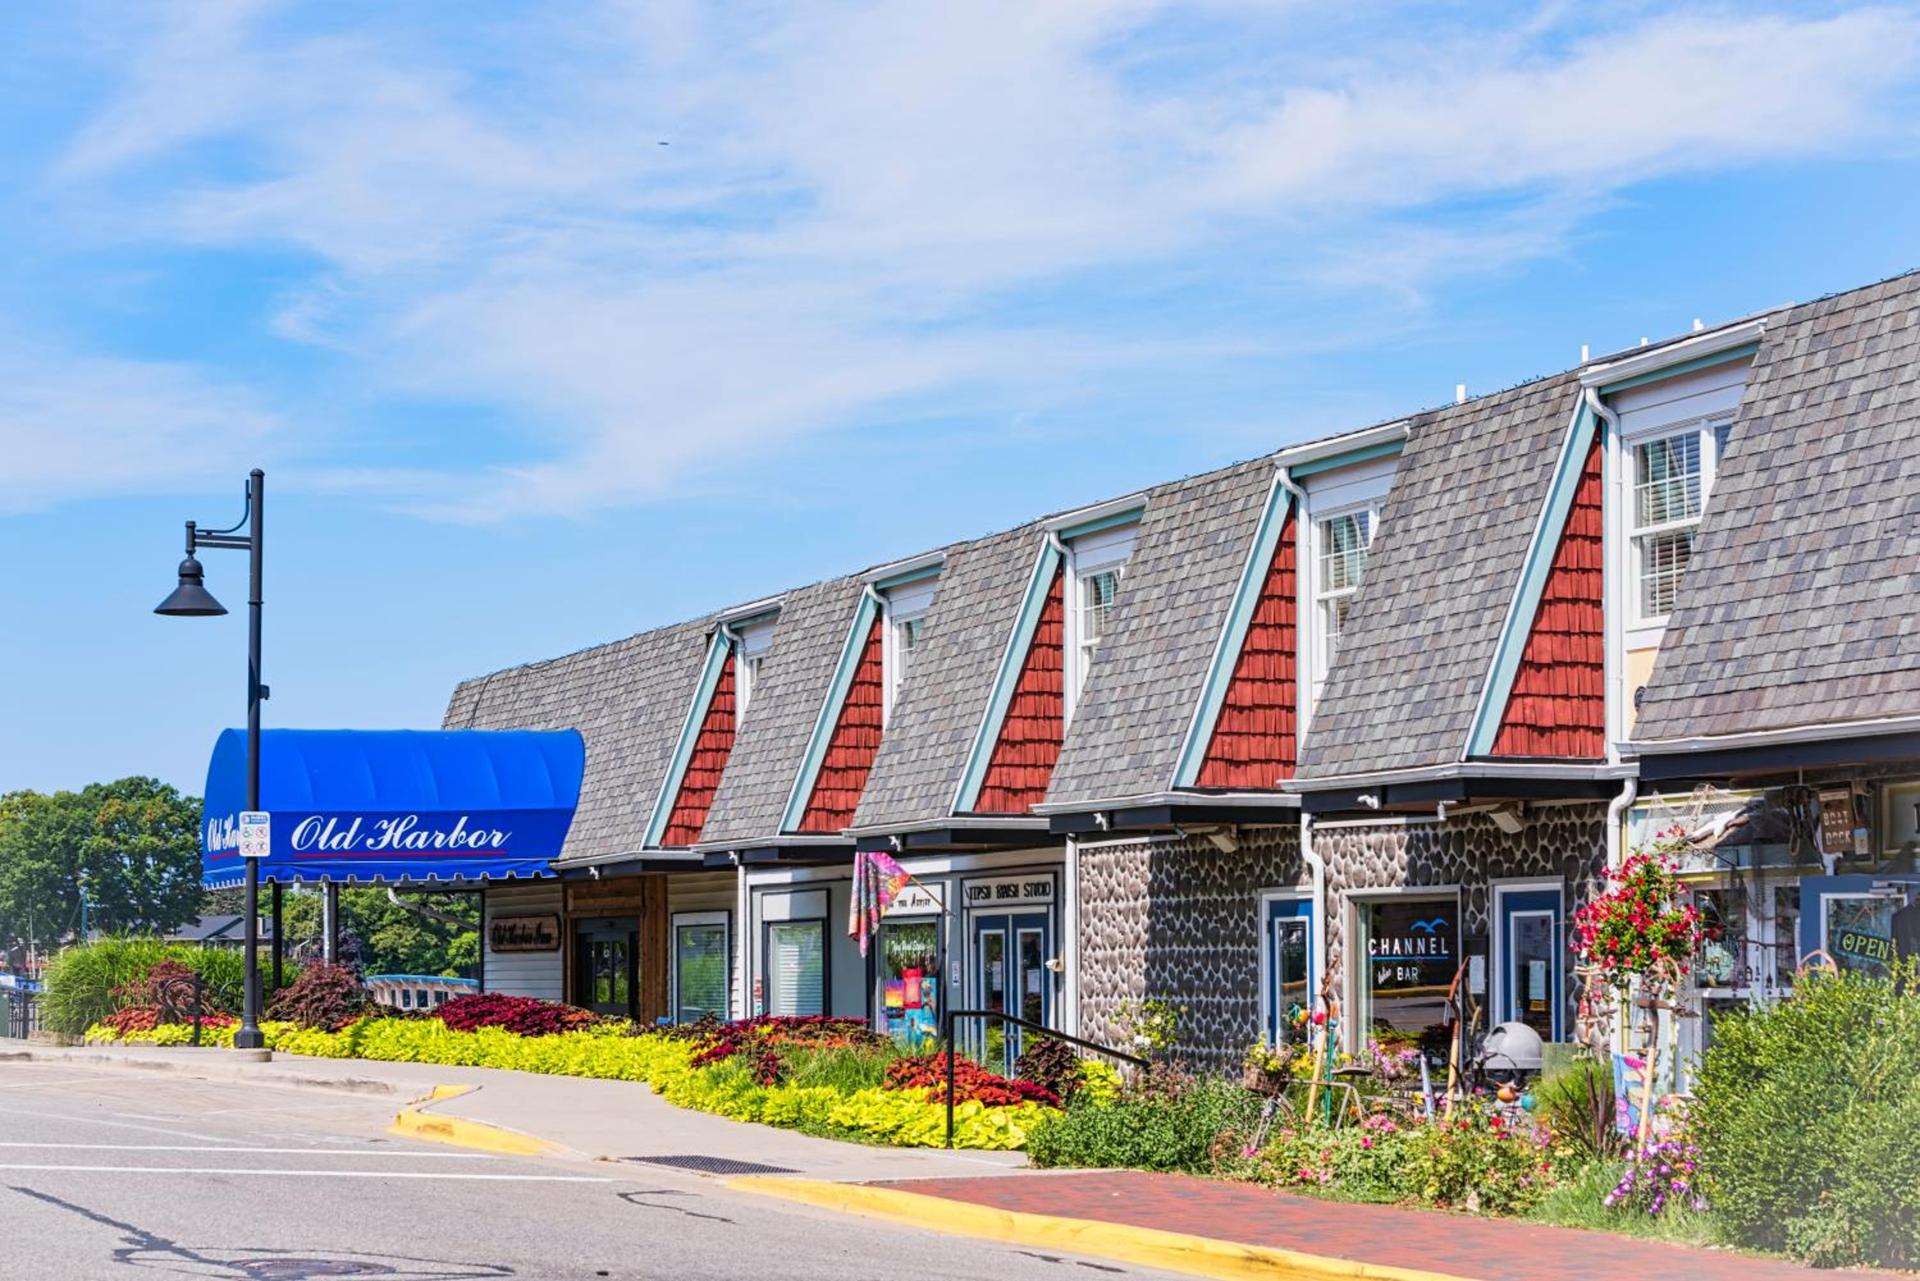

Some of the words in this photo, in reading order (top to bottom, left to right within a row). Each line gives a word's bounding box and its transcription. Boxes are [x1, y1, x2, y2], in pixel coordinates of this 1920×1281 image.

[1823, 811, 1849, 825] BOAT
[291, 815, 364, 850] Old
[366, 814, 512, 850] Harbor
[1825, 830, 1851, 845] DOCK
[1024, 882, 1051, 897] STUDIO
[1368, 937, 1449, 955] CHANNEL
[1842, 933, 1889, 960] OPEN
[1397, 966, 1418, 981] BAR
